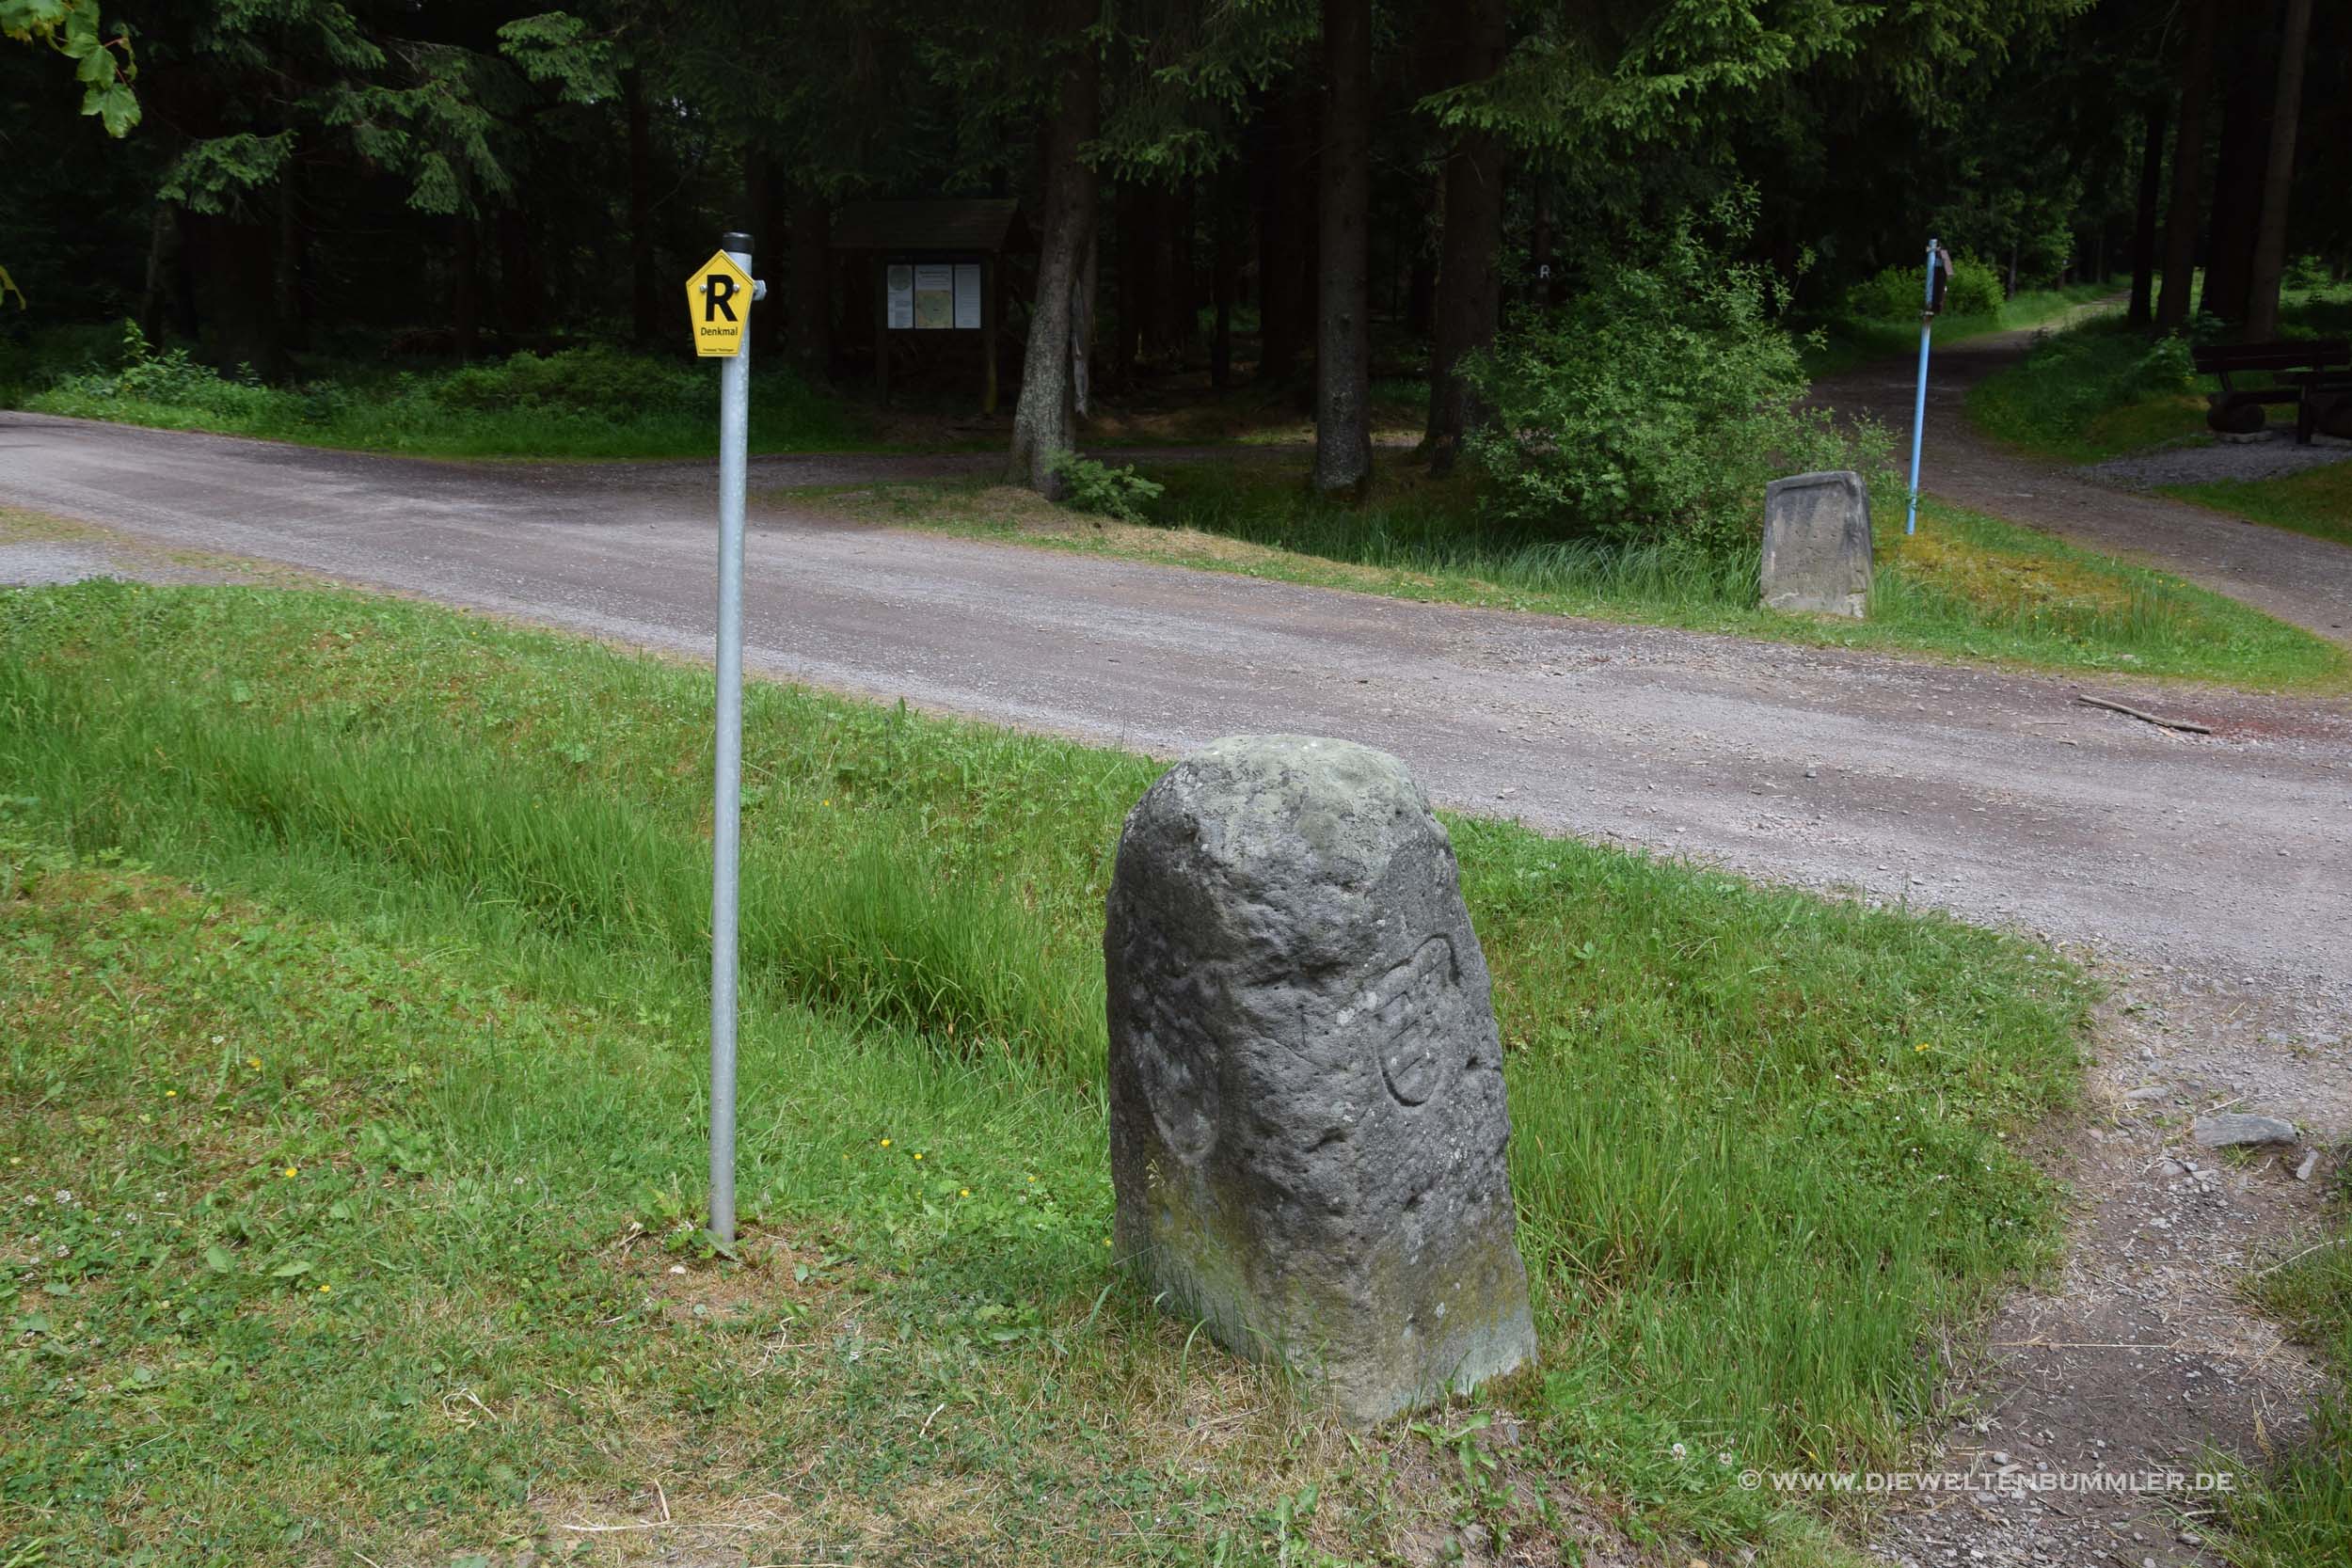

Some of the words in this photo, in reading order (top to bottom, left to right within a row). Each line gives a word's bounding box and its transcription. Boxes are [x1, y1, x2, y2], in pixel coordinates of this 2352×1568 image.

[1540, 264, 1550, 278] R
[706, 274, 739, 322] R
[700, 326, 739, 336] Denkmal
